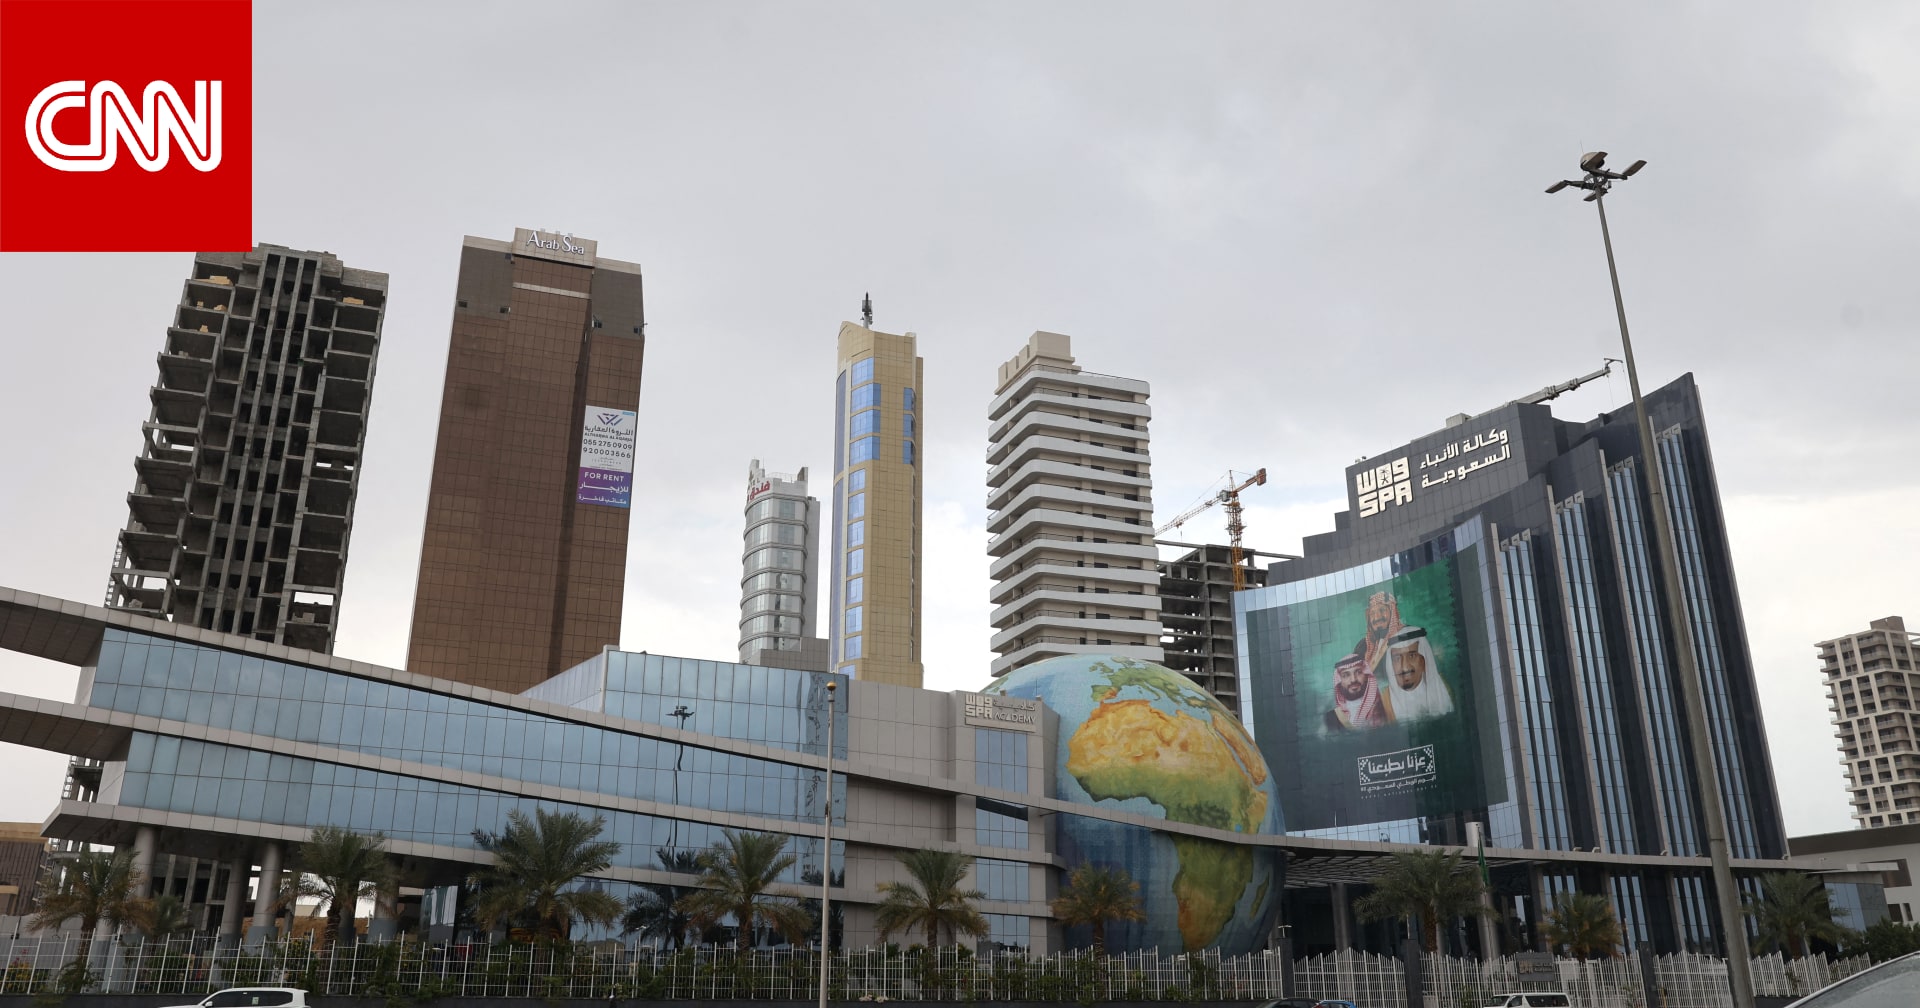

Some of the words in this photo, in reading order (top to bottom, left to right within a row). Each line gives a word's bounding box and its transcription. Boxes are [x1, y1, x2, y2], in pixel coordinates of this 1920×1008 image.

[526, 230, 560, 250] Arab
[561, 235, 585, 255] Sea
[1463, 428, 1509, 454] وكالة
[1420, 443, 1459, 469] الأنباء
[1421, 444, 1511, 488] السعودية
[584, 471, 602, 480] FOR
[603, 473, 624, 483] RENT
[1358, 479, 1413, 518] SPA
[965, 705, 993, 719] SPA
[994, 711, 1036, 725] ACADEMY
[1368, 757, 1405, 777] بطبعنا
